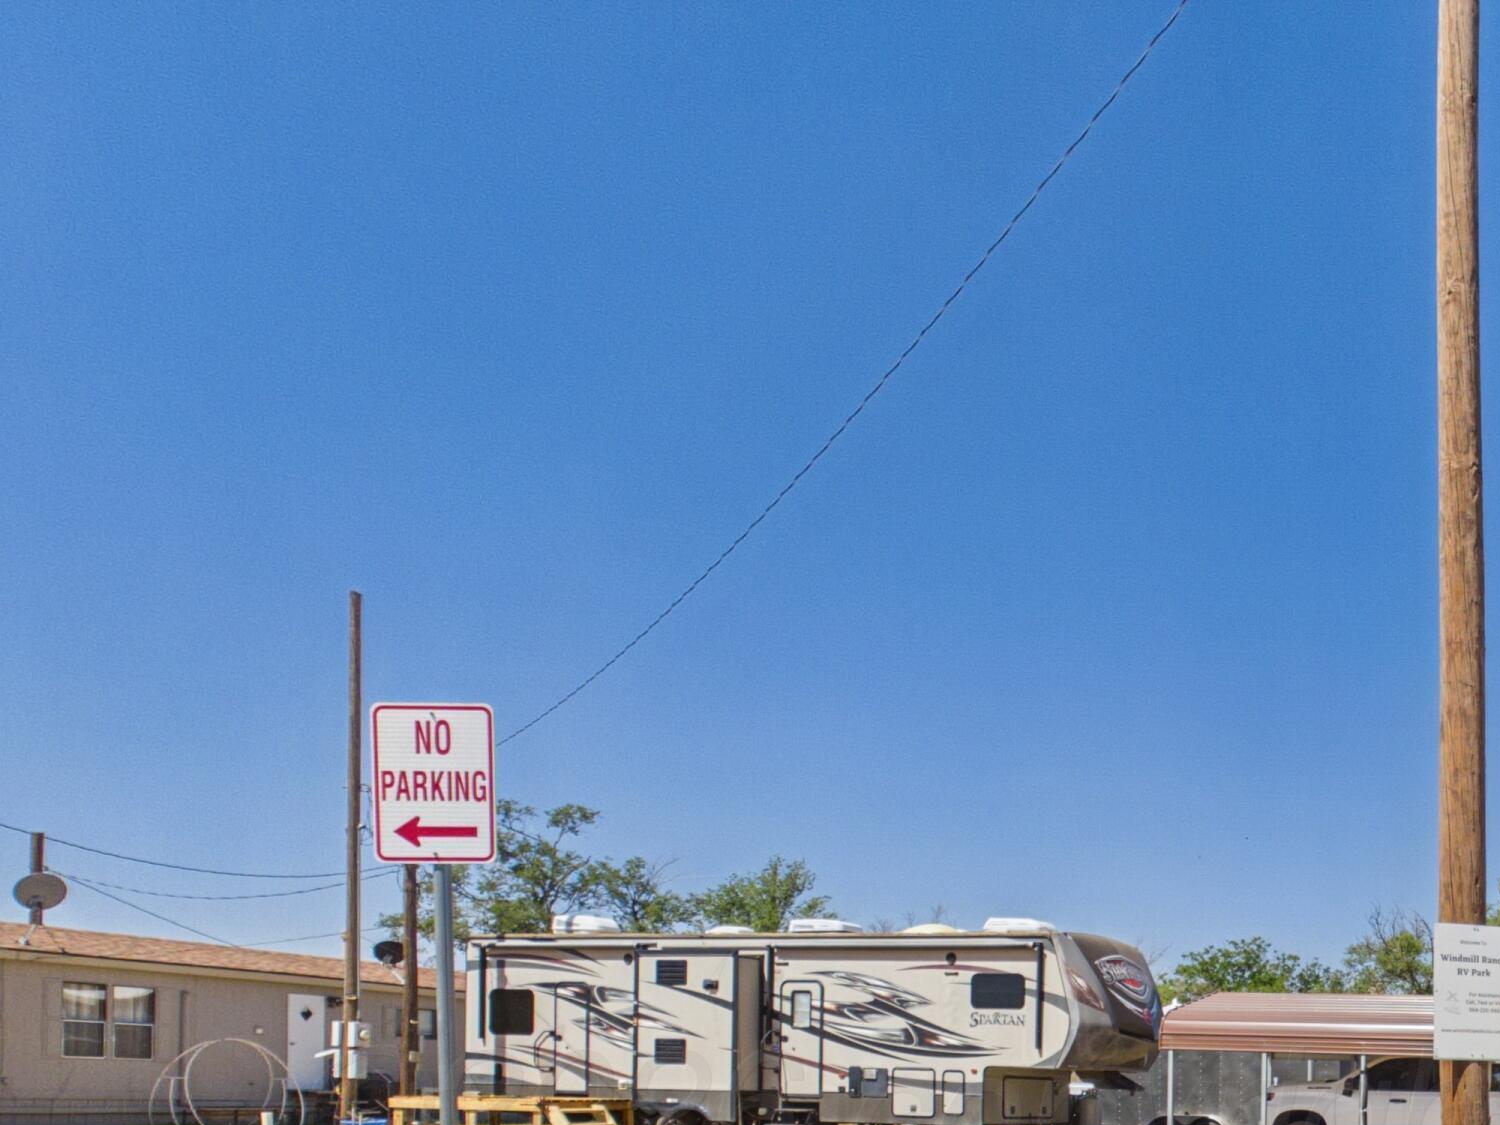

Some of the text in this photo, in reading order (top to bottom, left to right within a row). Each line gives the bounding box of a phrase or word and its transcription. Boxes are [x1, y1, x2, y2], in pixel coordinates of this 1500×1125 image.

[415, 719, 451, 755] NO
[381, 770, 487, 803] PARKING
[1440, 953, 1480, 964] Windmill
[1457, 967, 1491, 977] RV Park
